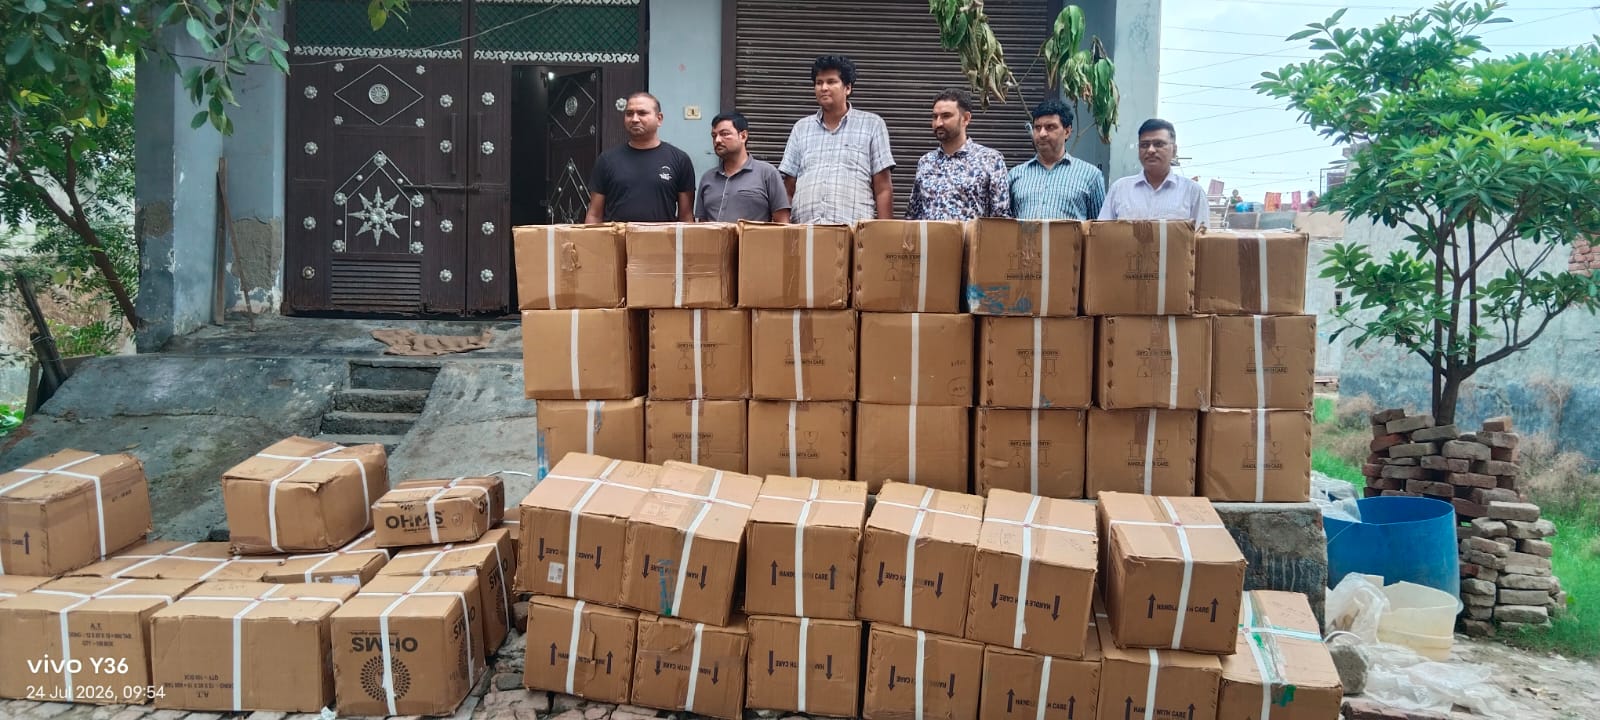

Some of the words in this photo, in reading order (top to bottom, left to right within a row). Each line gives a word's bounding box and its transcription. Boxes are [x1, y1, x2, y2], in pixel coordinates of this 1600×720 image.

[885, 572, 899, 580] CARE
[999, 594, 1014, 603] CARE
[1029, 600, 1051, 609] HANDLE
[1194, 605, 1209, 613] CARE
[663, 662, 676, 670] CARE
[1171, 711, 1186, 719] CARE
